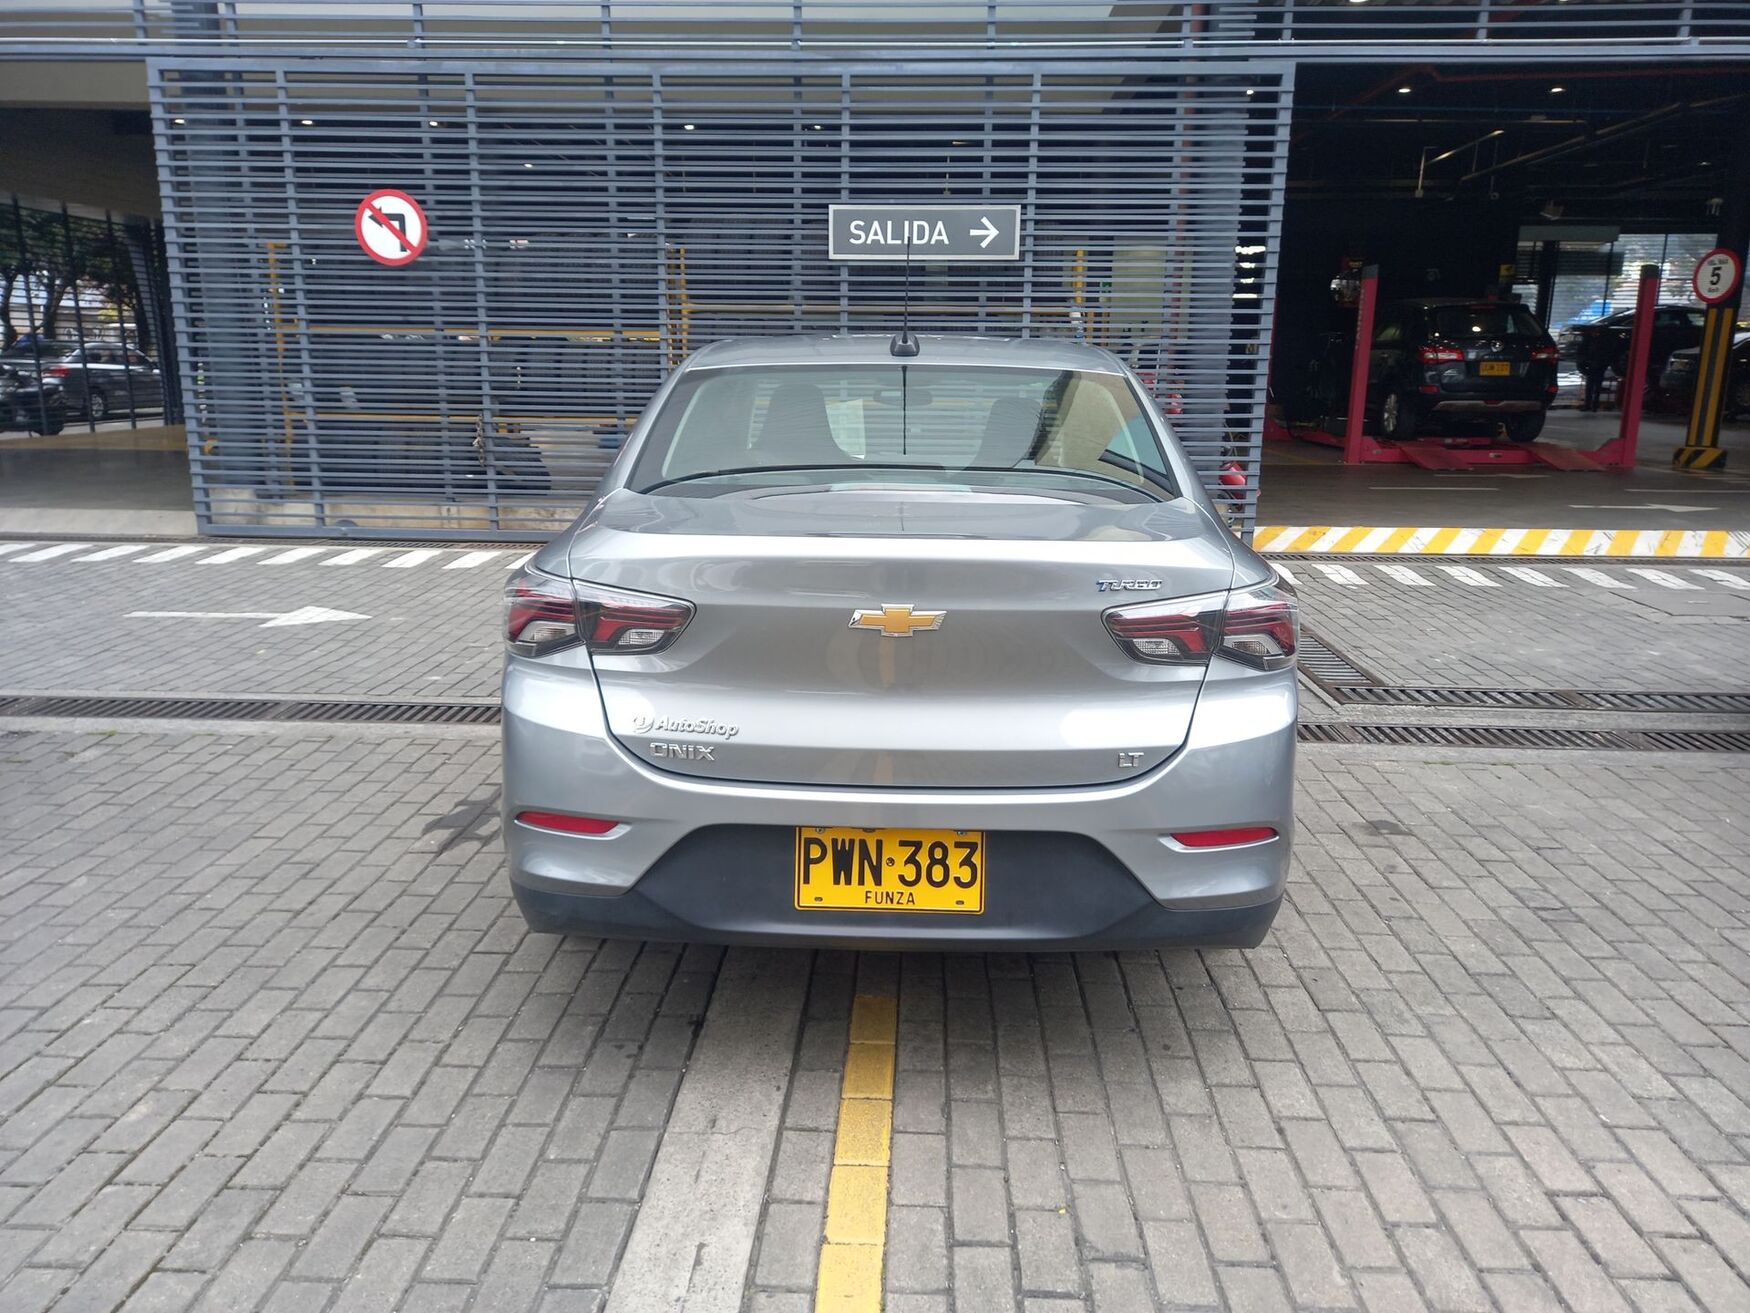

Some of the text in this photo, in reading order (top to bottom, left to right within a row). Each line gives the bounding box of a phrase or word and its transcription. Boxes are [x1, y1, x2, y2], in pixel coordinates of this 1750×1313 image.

[849, 220, 950, 245] SALIDA
[1710, 266, 1722, 286] 5
[1096, 579, 1163, 592] TURBO
[655, 717, 740, 740] AutoShop
[649, 742, 715, 761] ONIX
[1118, 752, 1145, 768] LT
[864, 890, 916, 906] FUNZA
